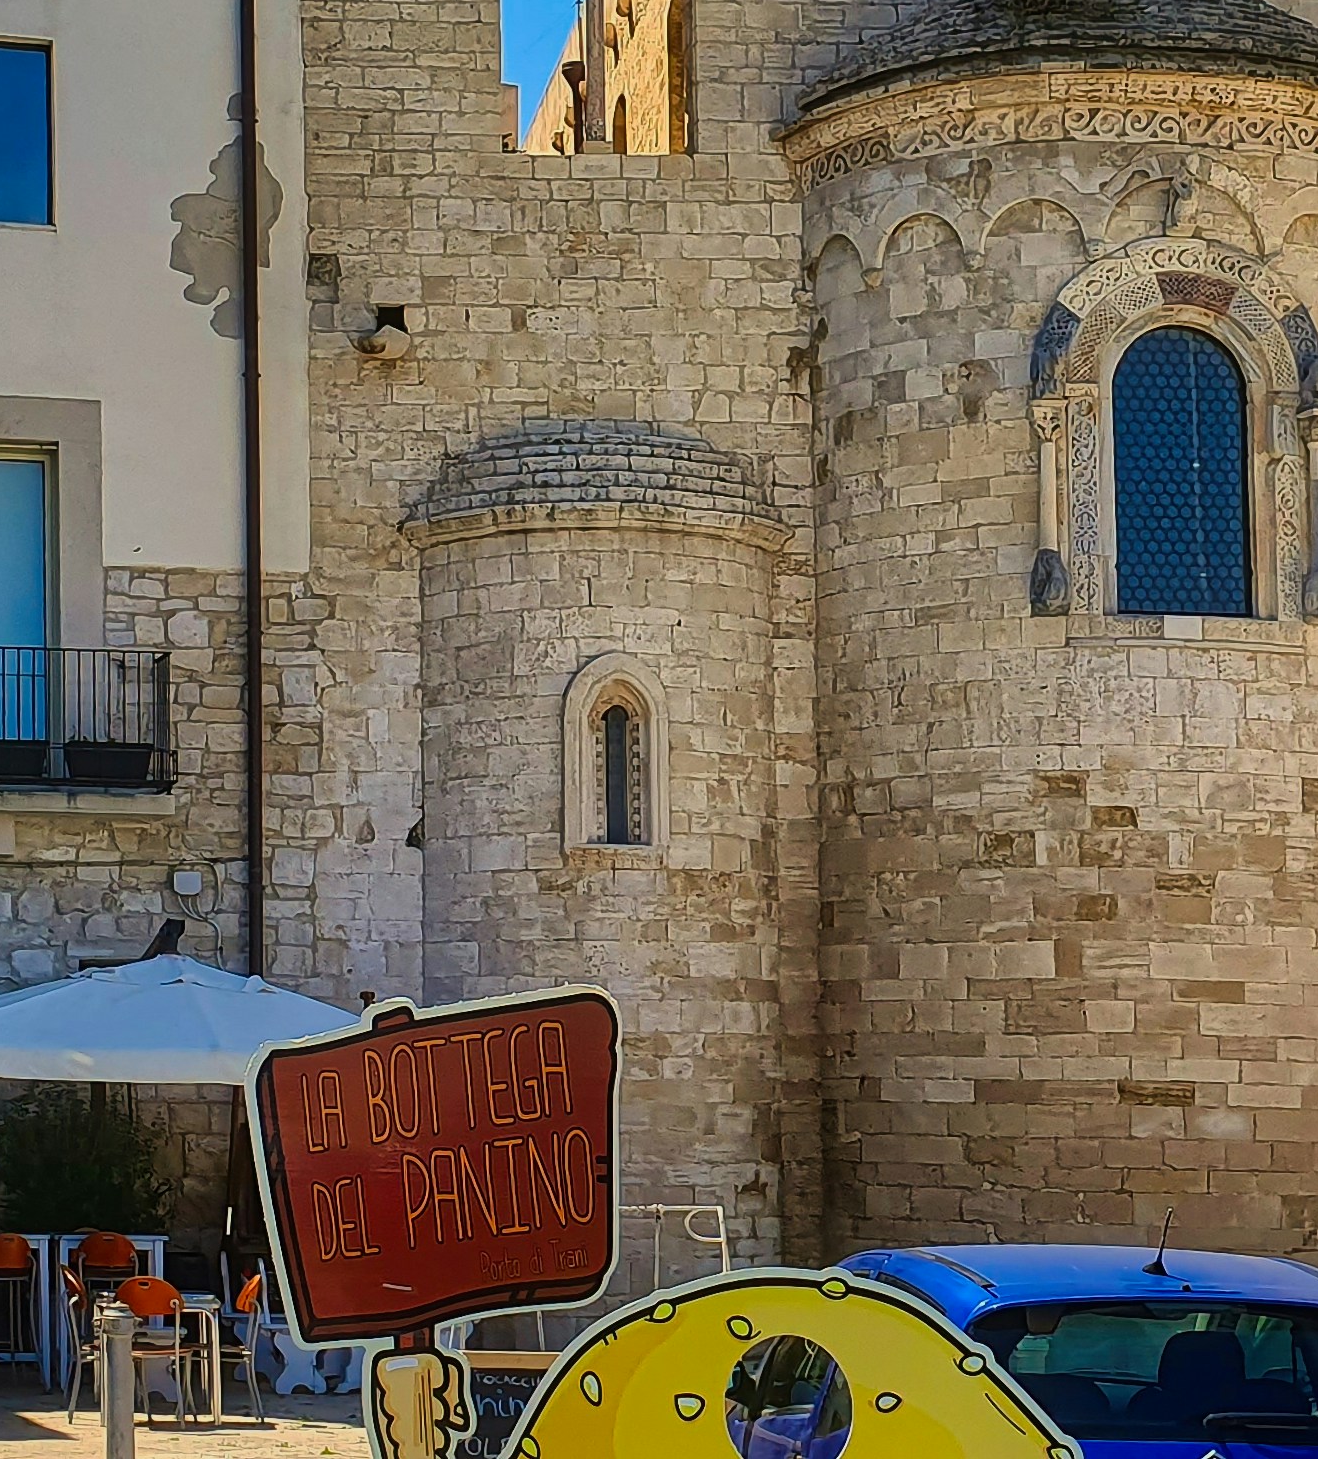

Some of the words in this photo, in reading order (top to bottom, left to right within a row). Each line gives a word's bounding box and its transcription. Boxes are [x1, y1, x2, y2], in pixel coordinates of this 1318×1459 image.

[300, 1070, 348, 1153] LA
[361, 1019, 574, 1145] BOTTEGA
[311, 1174, 381, 1262] DEL
[400, 1127, 597, 1250] PANINO
[529, 1245, 544, 1275] di
[548, 1239, 589, 1271] Trani
